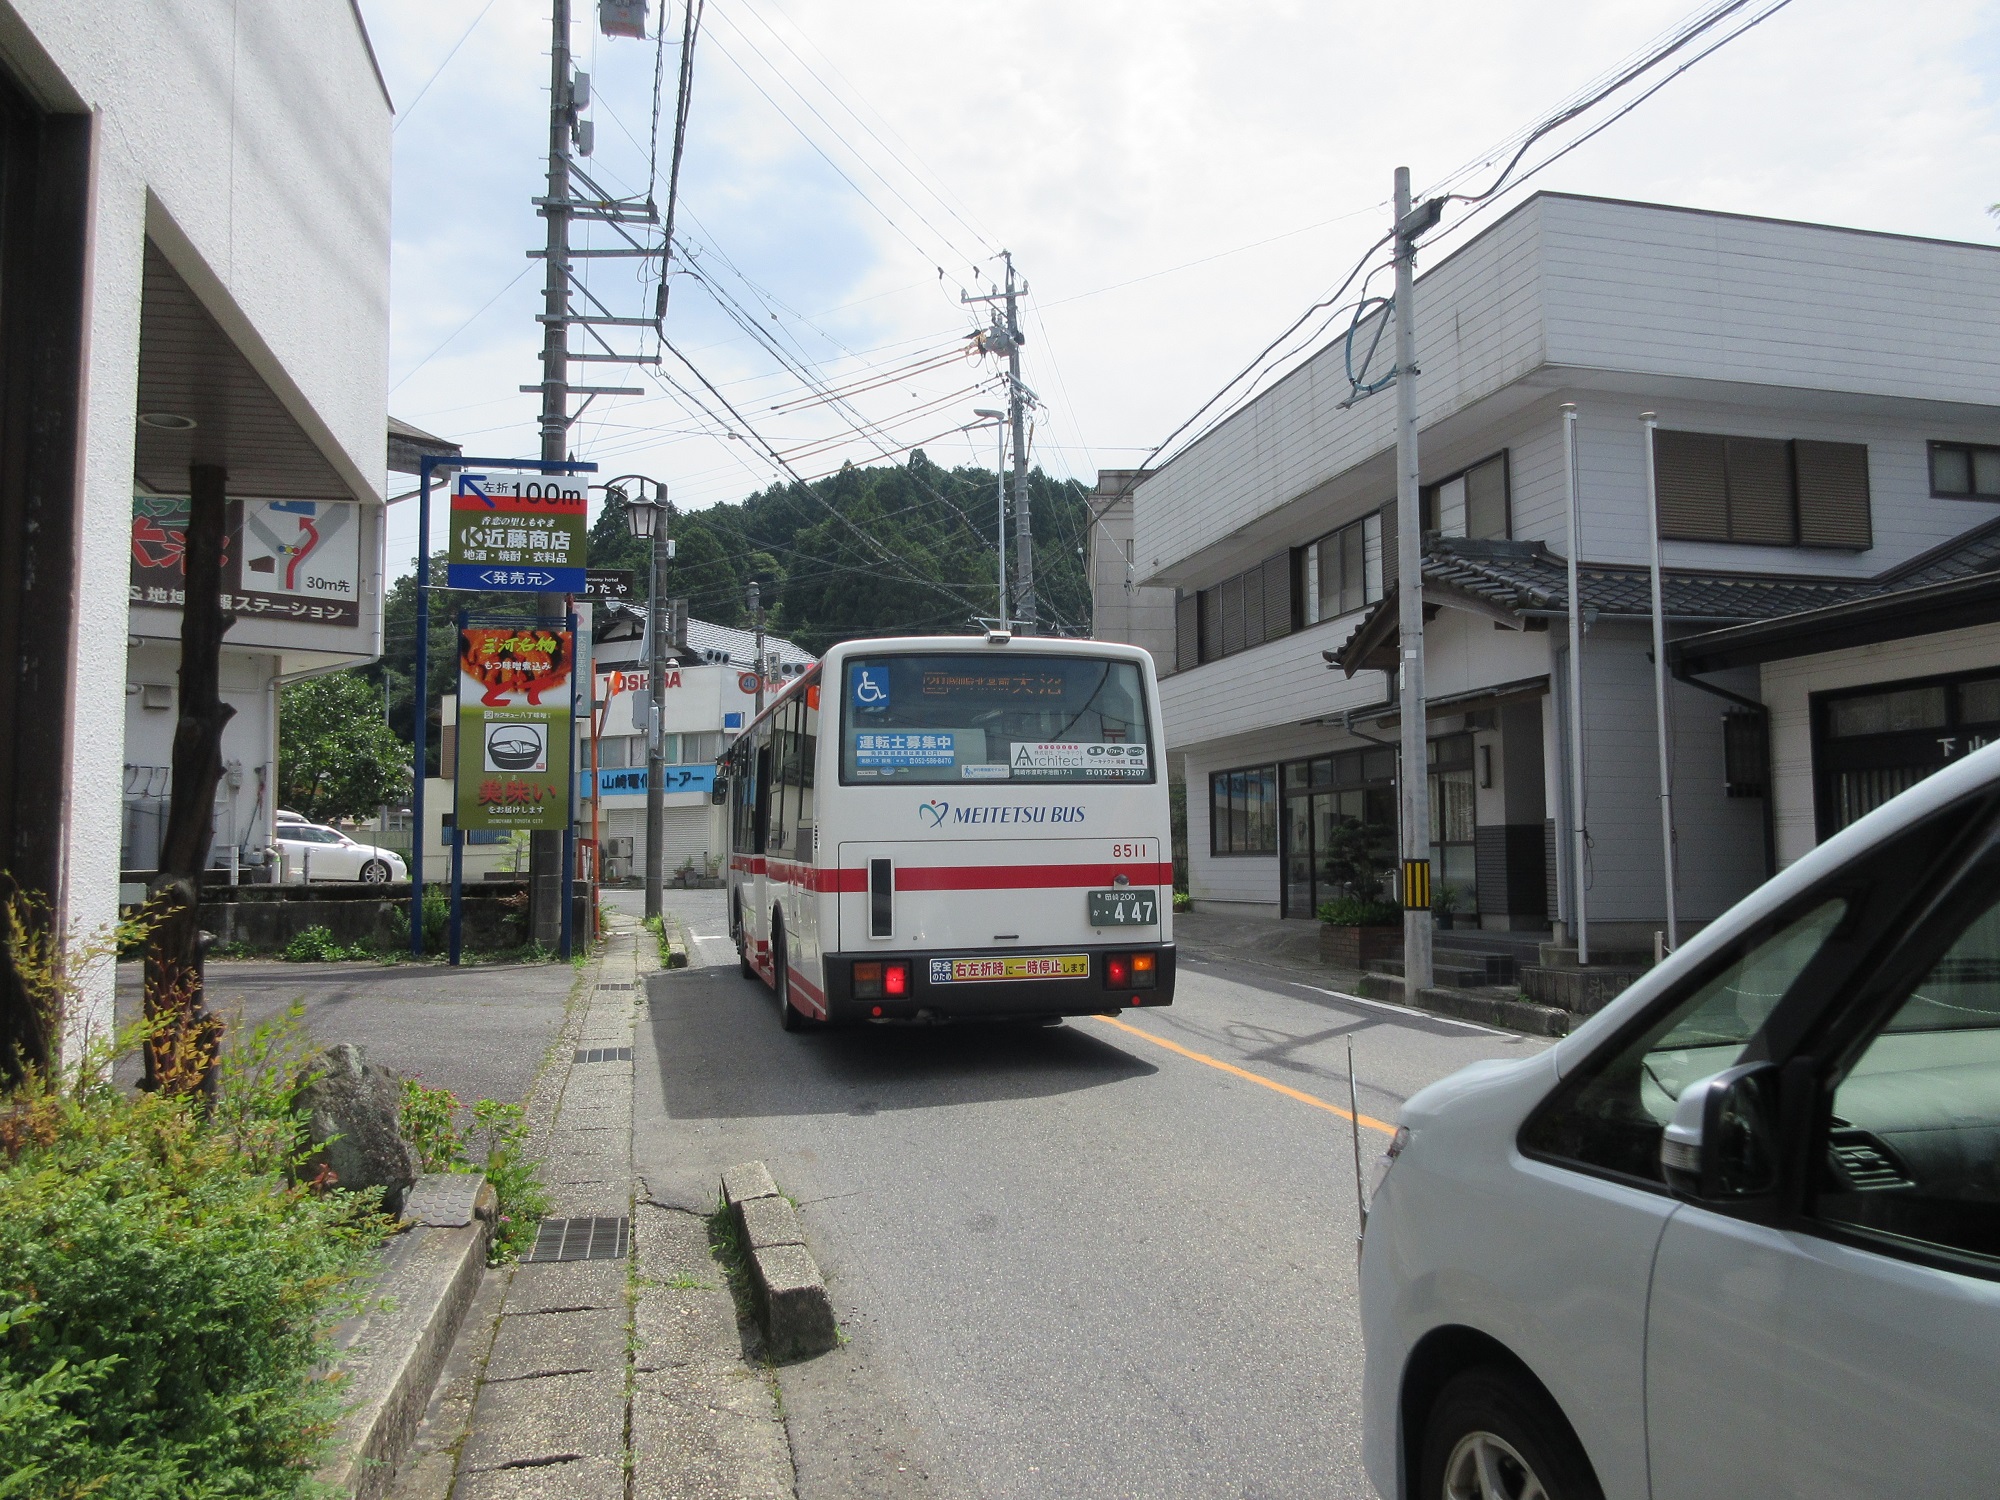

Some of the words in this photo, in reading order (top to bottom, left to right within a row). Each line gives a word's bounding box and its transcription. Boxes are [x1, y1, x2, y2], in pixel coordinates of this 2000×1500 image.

[483, 482, 508, 494] 左折
[512, 482, 581, 506] 100m
[484, 528, 571, 551] 近藤商店
[306, 577, 351, 594] 30m先
[147, 586, 344, 619] 地域報ステーション
[481, 637, 557, 654] 三河名物
[484, 661, 552, 671] もつ味噌煮込み
[743, 678, 757, 689] 40
[860, 735, 951, 749] 運転士募集中
[1014, 745, 1084, 767] Architect
[479, 779, 557, 806] 美味い
[488, 806, 545, 815] をお届けします
[953, 806, 1048, 824] MEITETSU
[1050, 805, 1086, 823] BUS
[1113, 844, 1146, 857] 8511
[932, 961, 952, 973] 安全
[932, 972, 952, 981] のため
